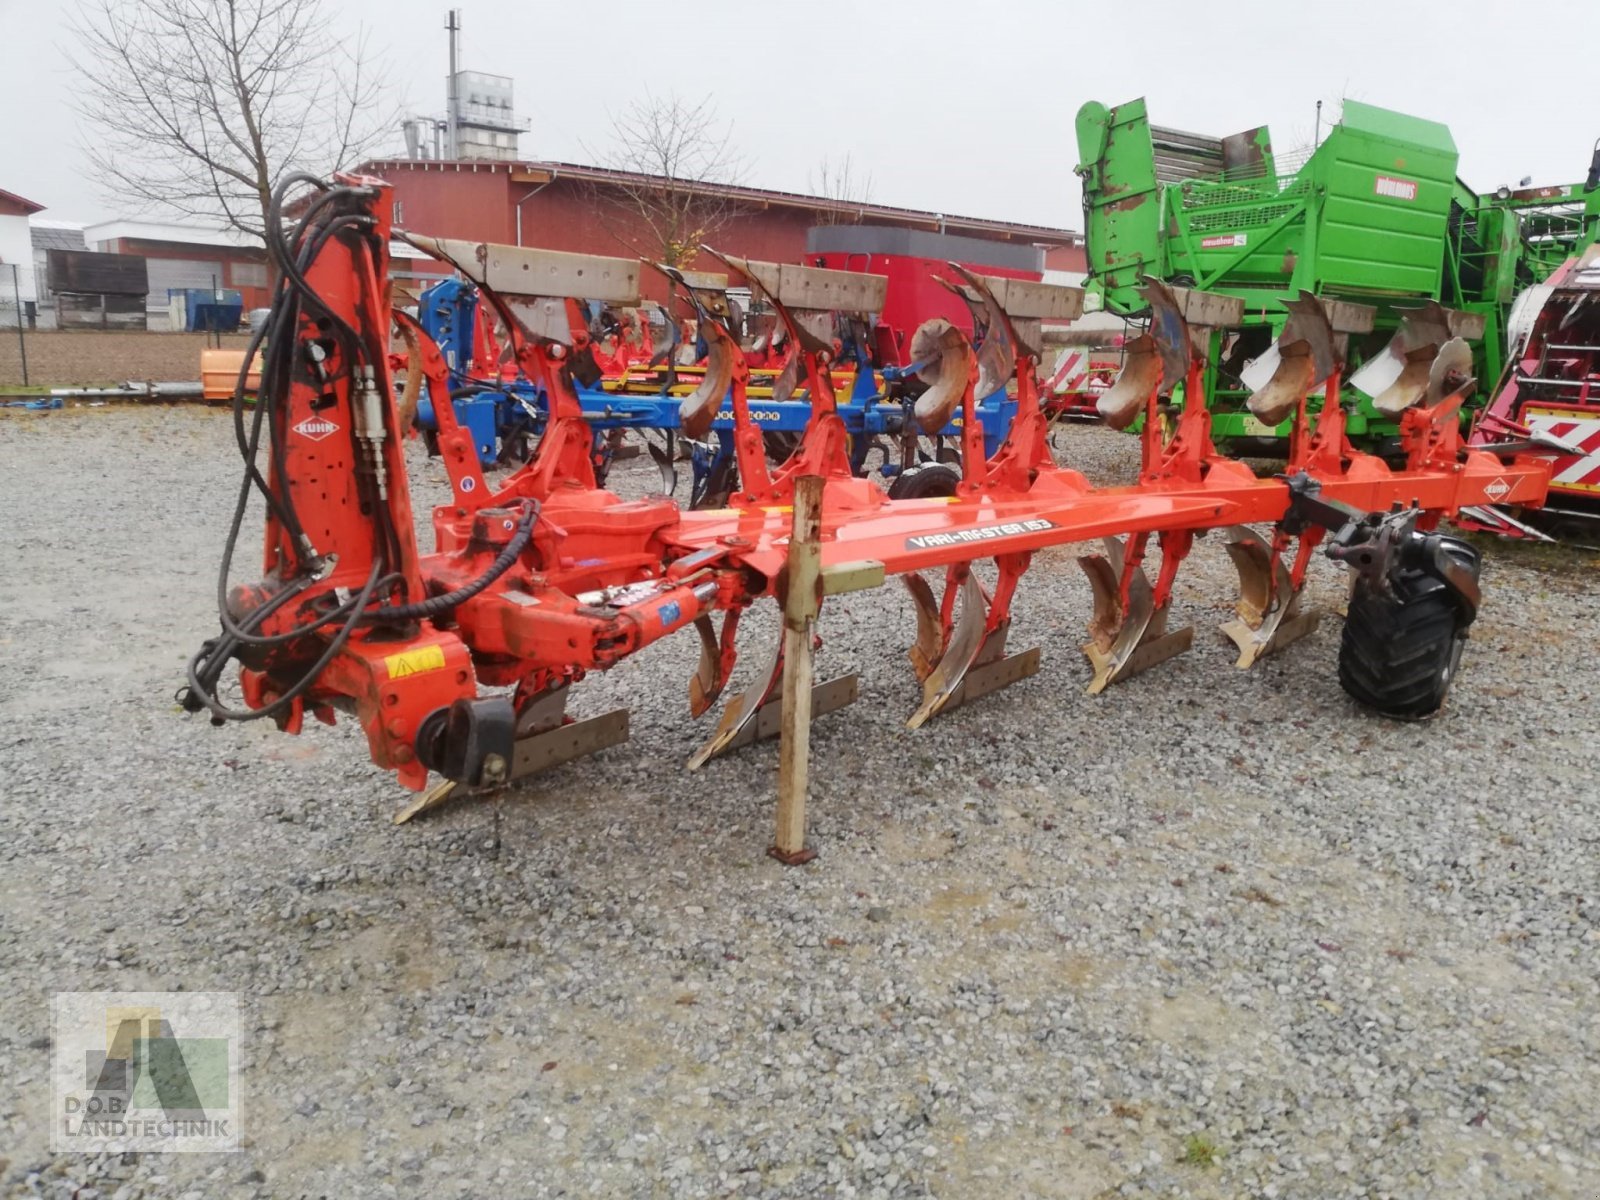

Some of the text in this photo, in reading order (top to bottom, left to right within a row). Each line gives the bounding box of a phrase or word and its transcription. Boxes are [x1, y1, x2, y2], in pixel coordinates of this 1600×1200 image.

[299, 422, 334, 433] KUHN
[910, 519, 1053, 548] VARI-MASTER 153
